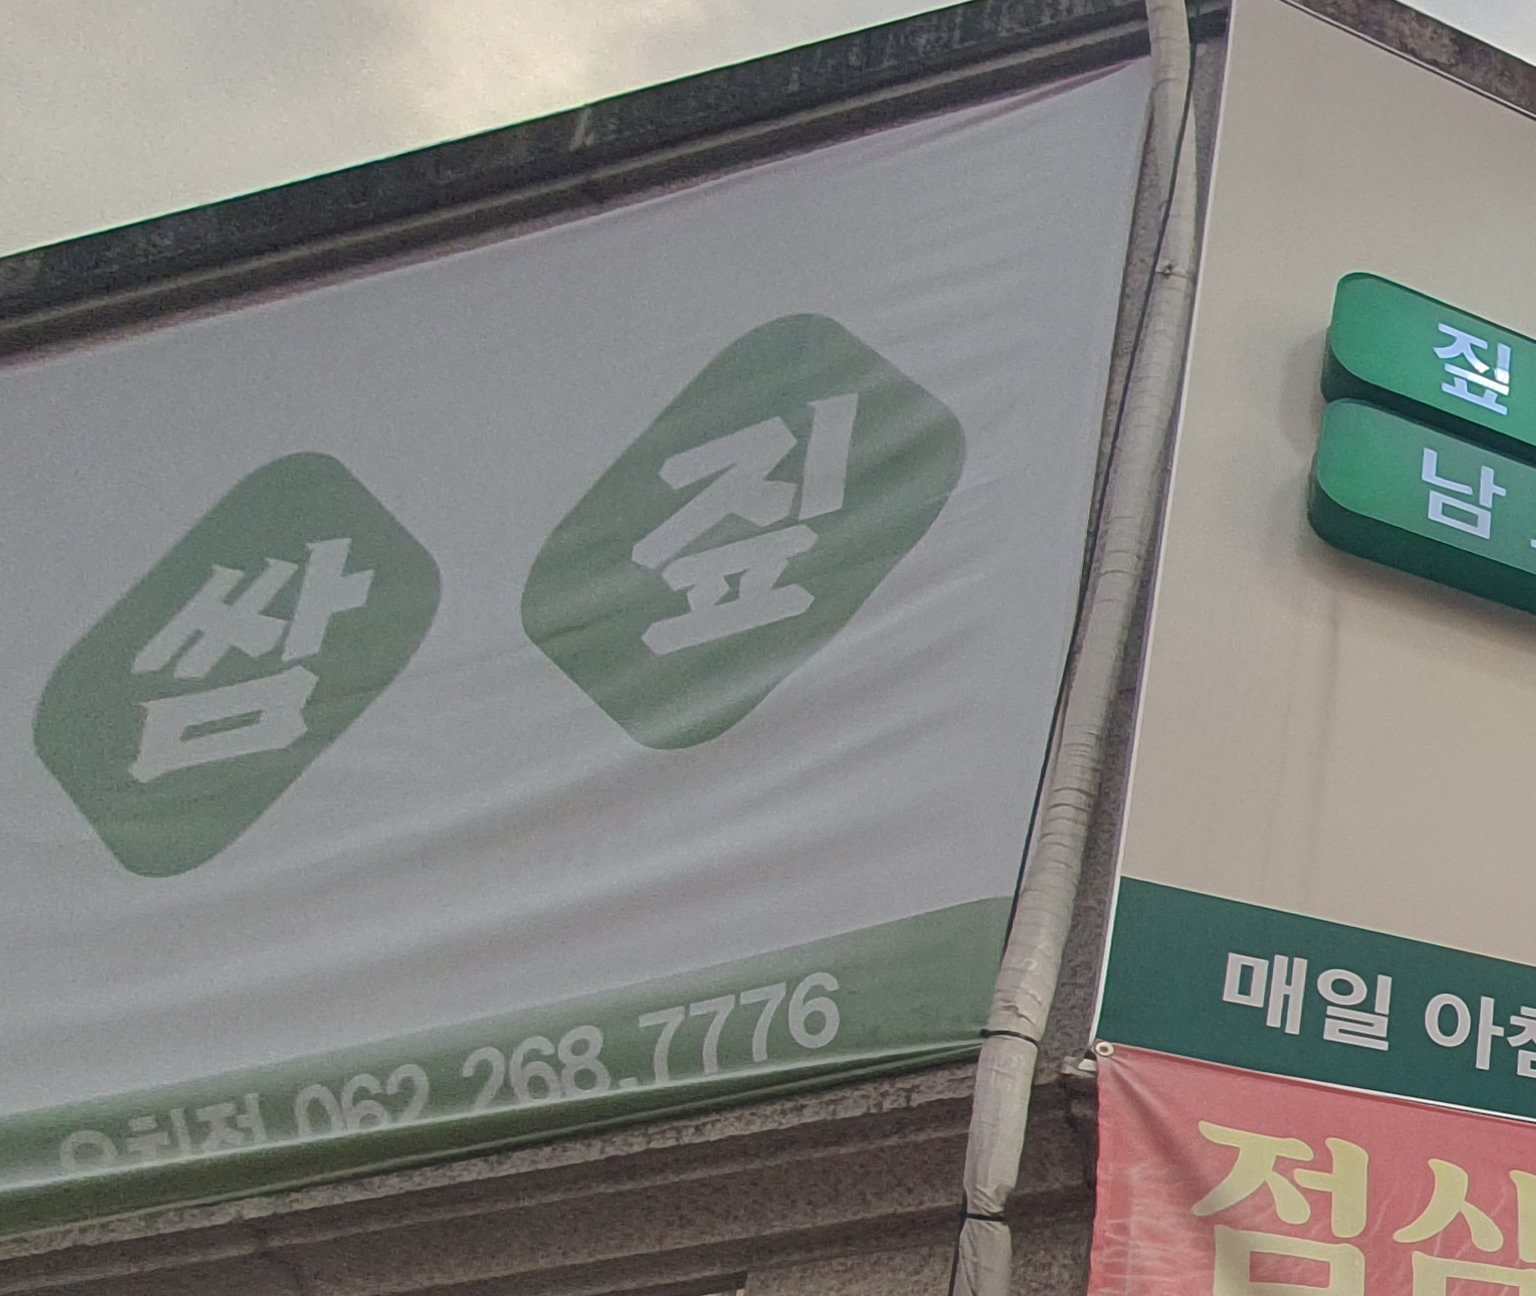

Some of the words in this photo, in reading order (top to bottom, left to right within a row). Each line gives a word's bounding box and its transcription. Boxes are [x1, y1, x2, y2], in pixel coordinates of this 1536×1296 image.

[127, 537, 375, 785] 쌈
[631, 392, 860, 656] 짚
[293, 1064, 430, 1141] 062
[462, 970, 842, 1111] 268.7776
[1221, 949, 1396, 1053] 매일
